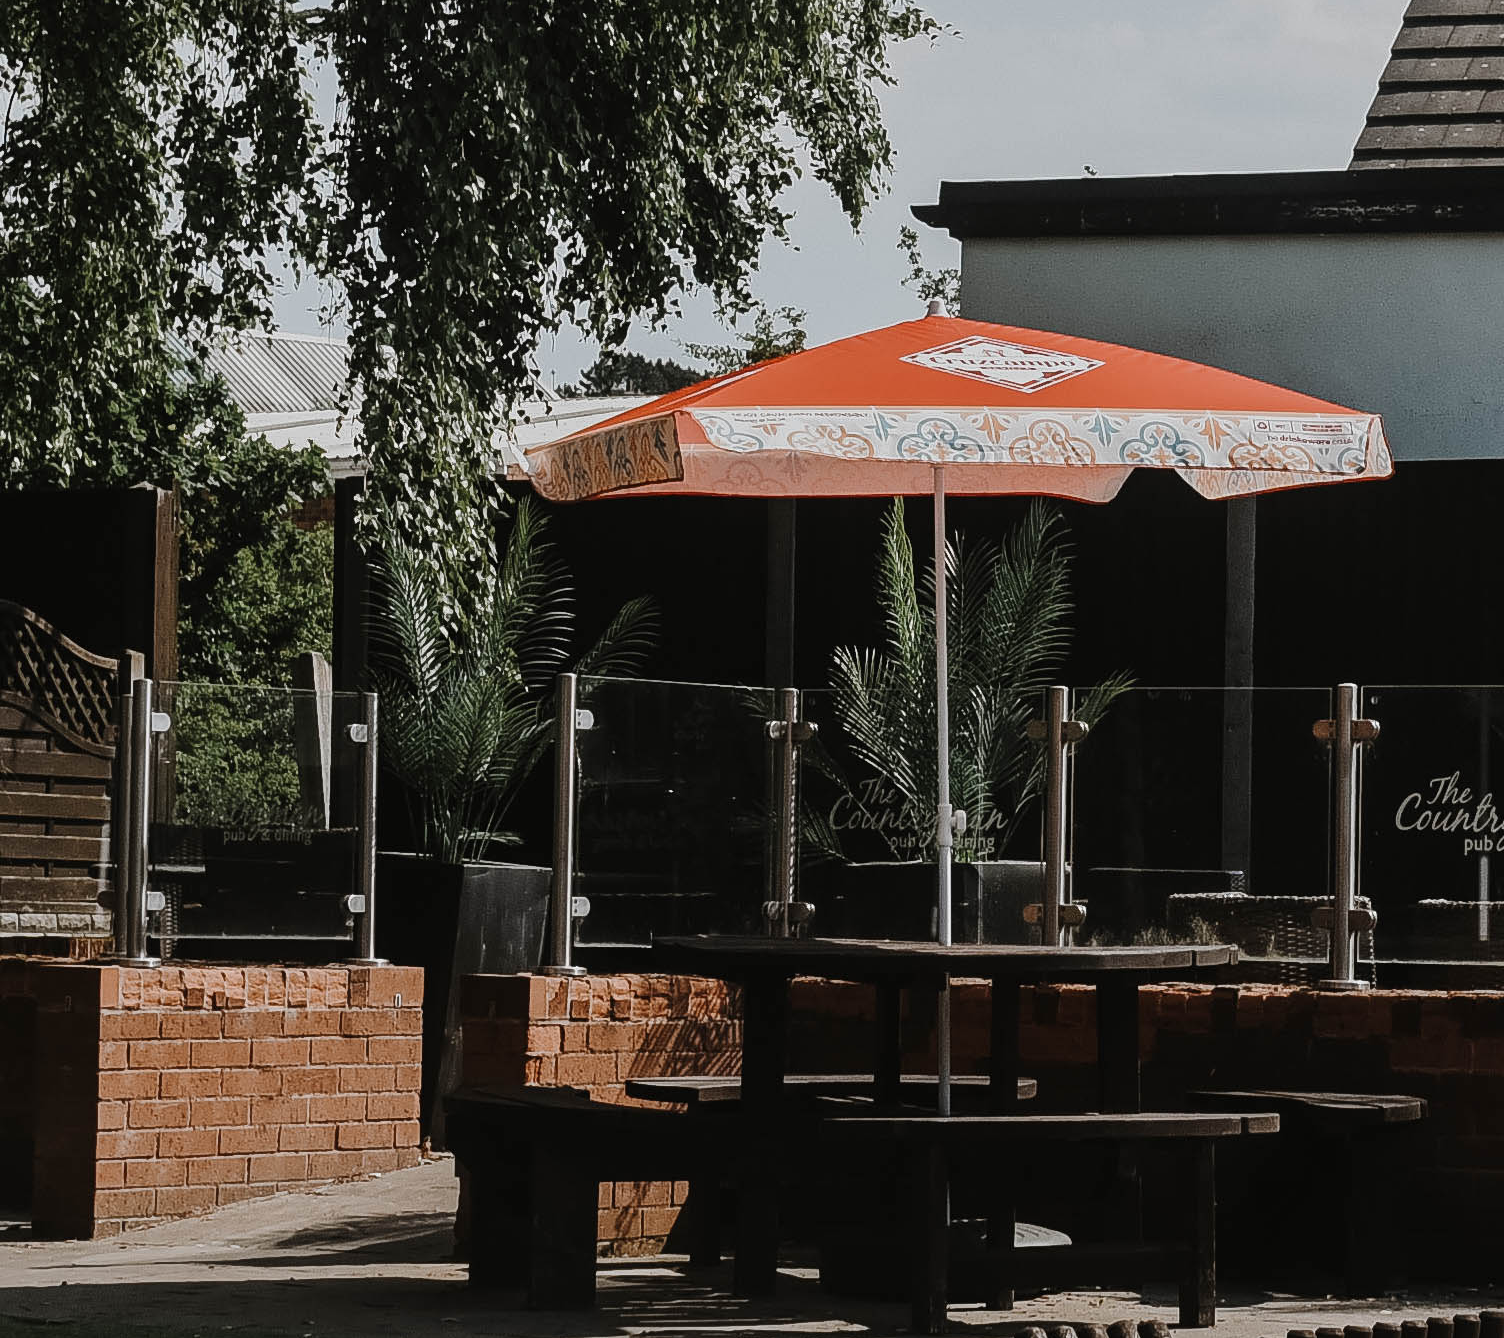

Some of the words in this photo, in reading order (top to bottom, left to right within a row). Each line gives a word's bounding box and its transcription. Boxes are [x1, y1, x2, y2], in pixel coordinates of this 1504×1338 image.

[929, 356, 1076, 368] Cruzcampo
[859, 774, 898, 805] The
[1426, 770, 1473, 805] The
[1464, 835, 1494, 856] pub
